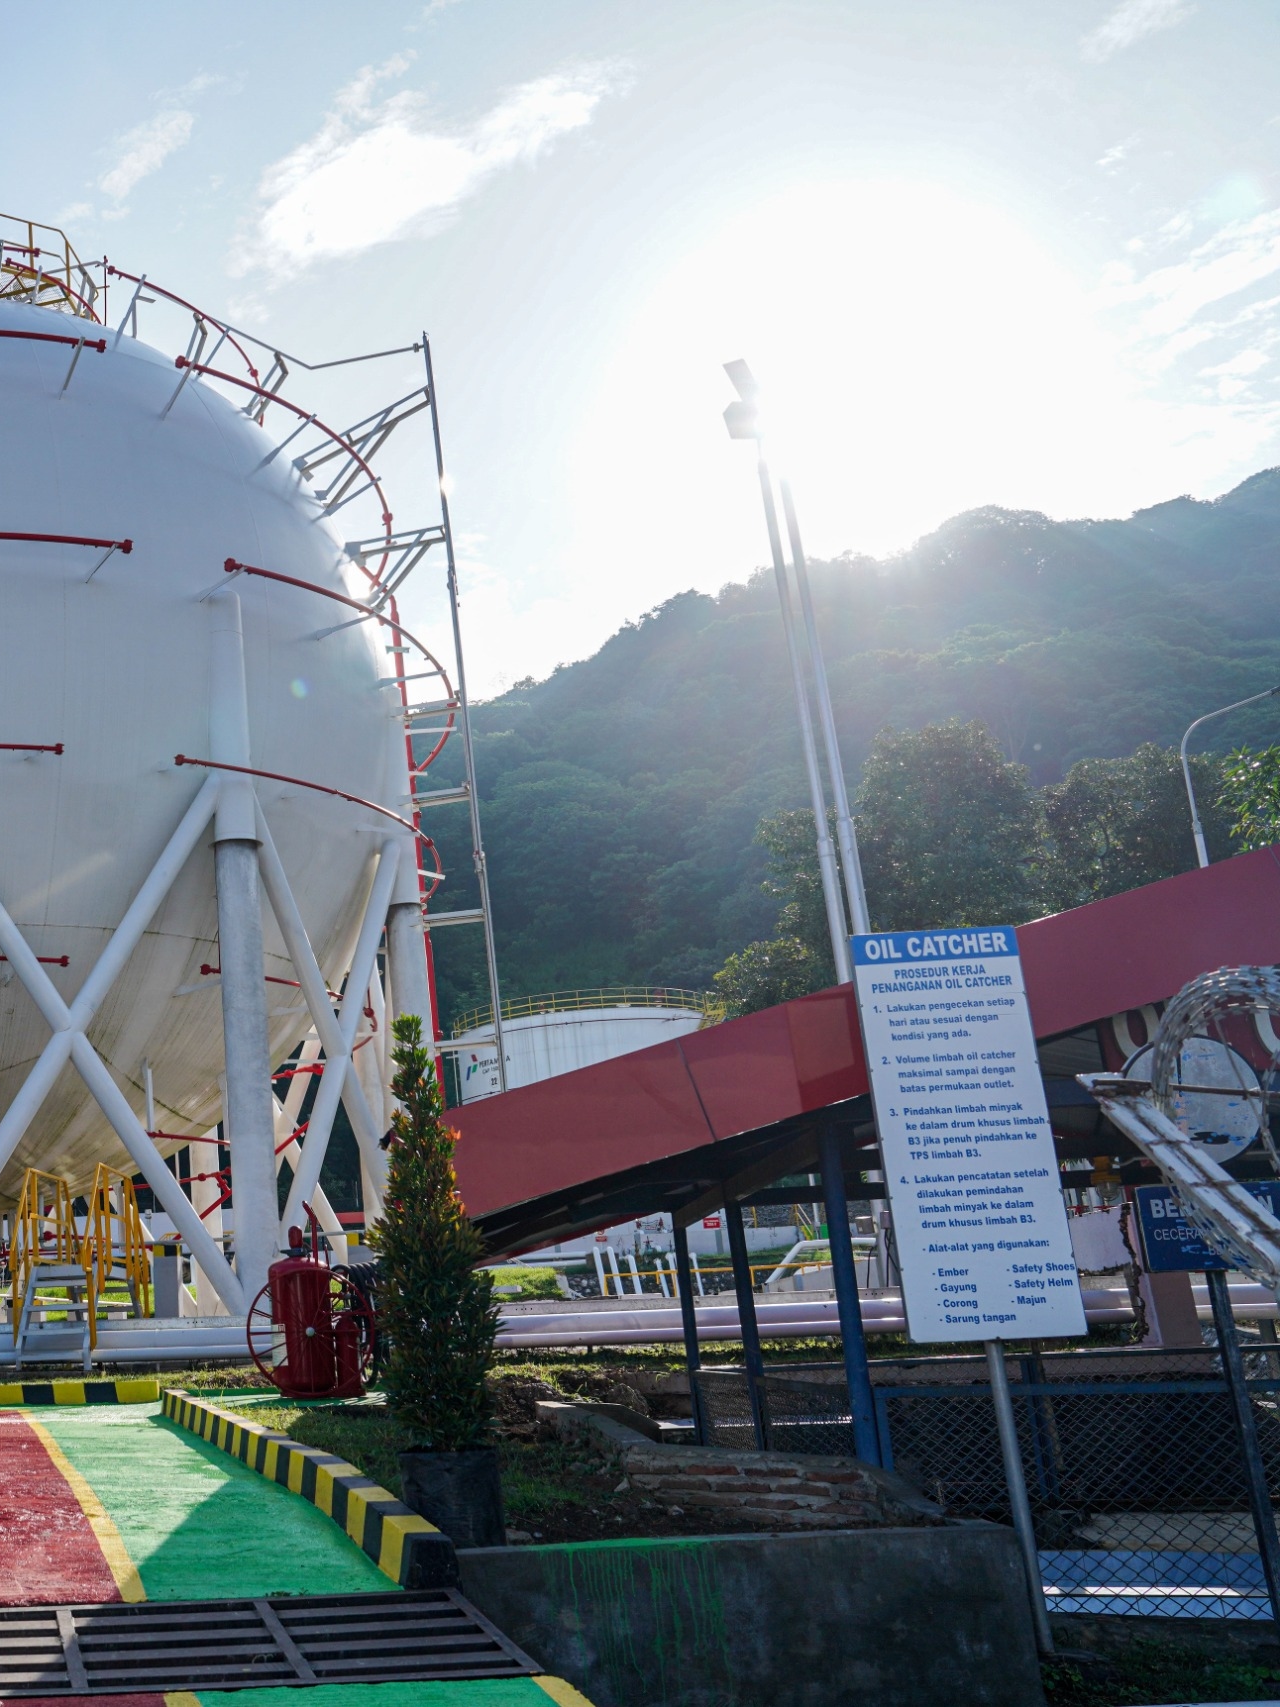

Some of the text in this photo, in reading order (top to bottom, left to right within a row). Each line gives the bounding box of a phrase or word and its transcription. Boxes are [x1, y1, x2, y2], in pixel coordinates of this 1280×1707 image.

[865, 933, 1008, 959] OIL CATCHER
[894, 965, 986, 979] PROSEDUR KERJA
[872, 976, 1012, 993] PENANGANAN OIL CATCHER
[887, 1004, 926, 1012] Lakukan
[929, 1000, 984, 1011] pengecekan
[987, 998, 1015, 1008] setiap
[965, 1014, 998, 1023] dengan
[891, 1029, 971, 1041] kondisi yang ada.
[882, 1056, 890, 1064] 2.
[933, 1053, 963, 1061] limbah
[967, 1052, 978, 1060] oil
[981, 1051, 1015, 1059] catcher
[898, 1066, 1015, 1078] maksimal sampai dengan
[929, 1082, 981, 1093] permukaan
[984, 1080, 1014, 1088] outlet.
[904, 1107, 952, 1115] Pindahkan
[955, 1104, 986, 1113] limbah
[989, 1103, 1022, 1112] minyak
[951, 1120, 975, 1128] drum
[978, 1119, 1011, 1127] khusus
[1013, 1116, 1045, 1125] limbah
[908, 1137, 920, 1145] B3
[923, 1136, 940, 1146] jika
[943, 1135, 971, 1145] penuh
[975, 1133, 1023, 1144] pindahkan
[910, 1149, 981, 1160] TPS limbah B3.
[900, 1168, 1048, 1184] 4. Lakukan pencatatan setelah
[917, 1186, 1023, 1198] dilakukan pemindahan
[919, 1204, 951, 1213] limbah
[954, 1202, 988, 1212] minyak
[1005, 1200, 1033, 1208] dalam
[949, 1219, 982, 1227] khusus
[986, 1216, 1017, 1225] limbah
[1020, 1215, 1035, 1223] B3.
[929, 1239, 1049, 1252] Alat-alat yang digunakan:
[938, 1268, 968, 1276] Ember
[1012, 1262, 1075, 1274] Safety Shoes
[941, 1284, 977, 1293] Gayung
[1015, 1277, 1073, 1289] Safety Helm
[943, 1299, 978, 1308] Corong
[1017, 1296, 1046, 1306] Majun
[946, 1314, 1016, 1324] Sarung tangan
